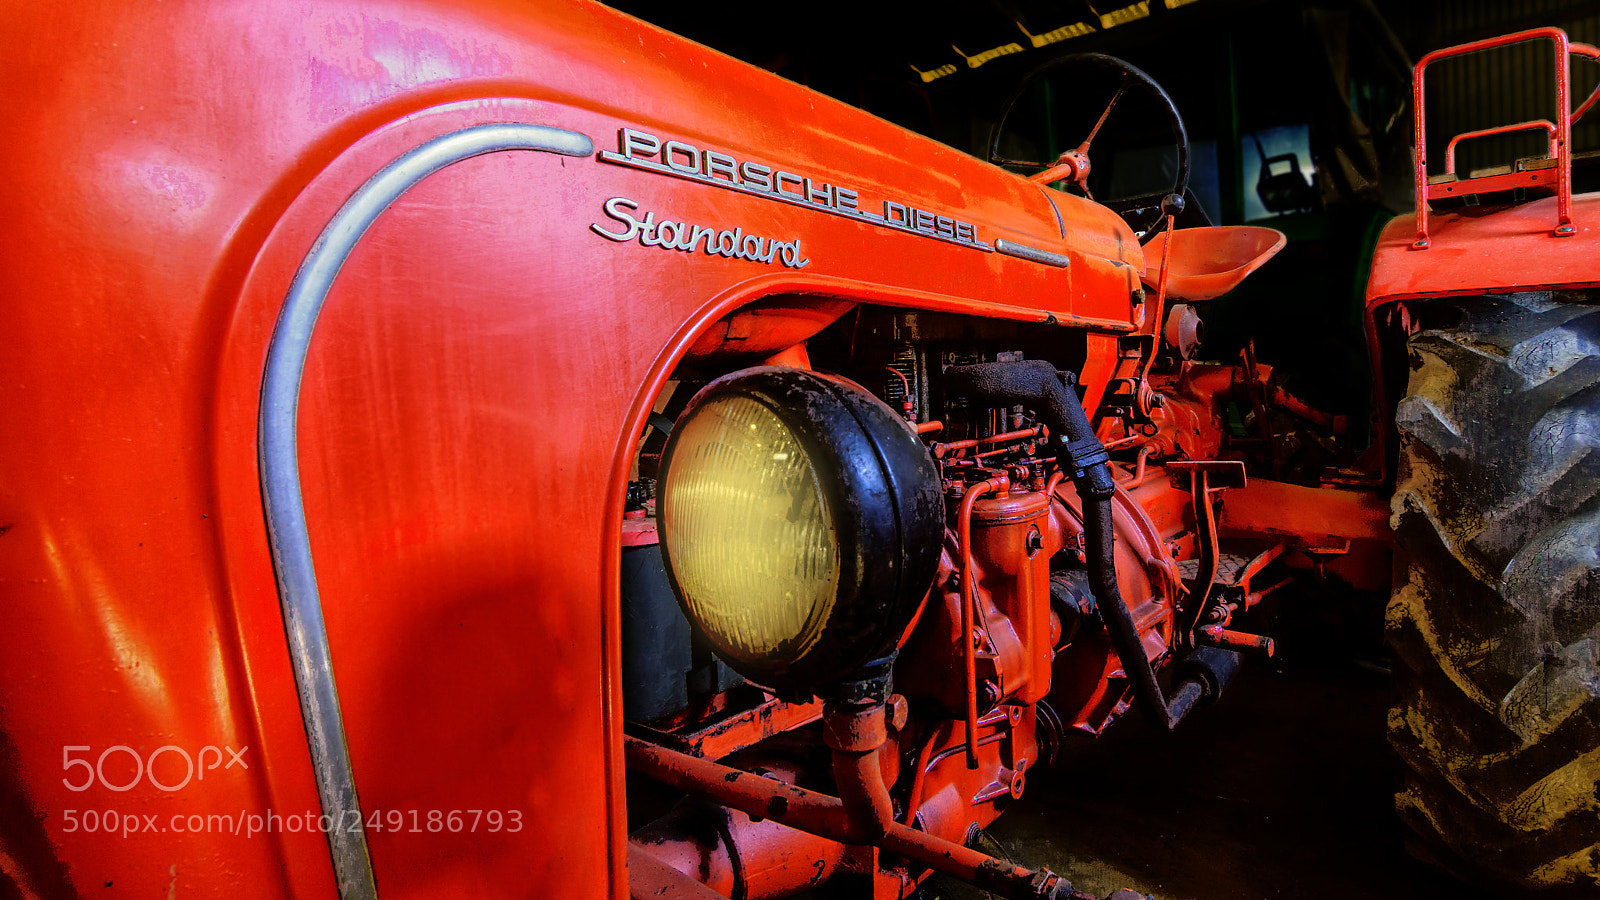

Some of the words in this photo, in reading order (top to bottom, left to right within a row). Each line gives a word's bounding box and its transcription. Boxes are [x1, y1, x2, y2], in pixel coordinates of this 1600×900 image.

[591, 196, 810, 269] Standard
[618, 127, 860, 213] PORSCHE
[883, 200, 989, 248] DIESEL
